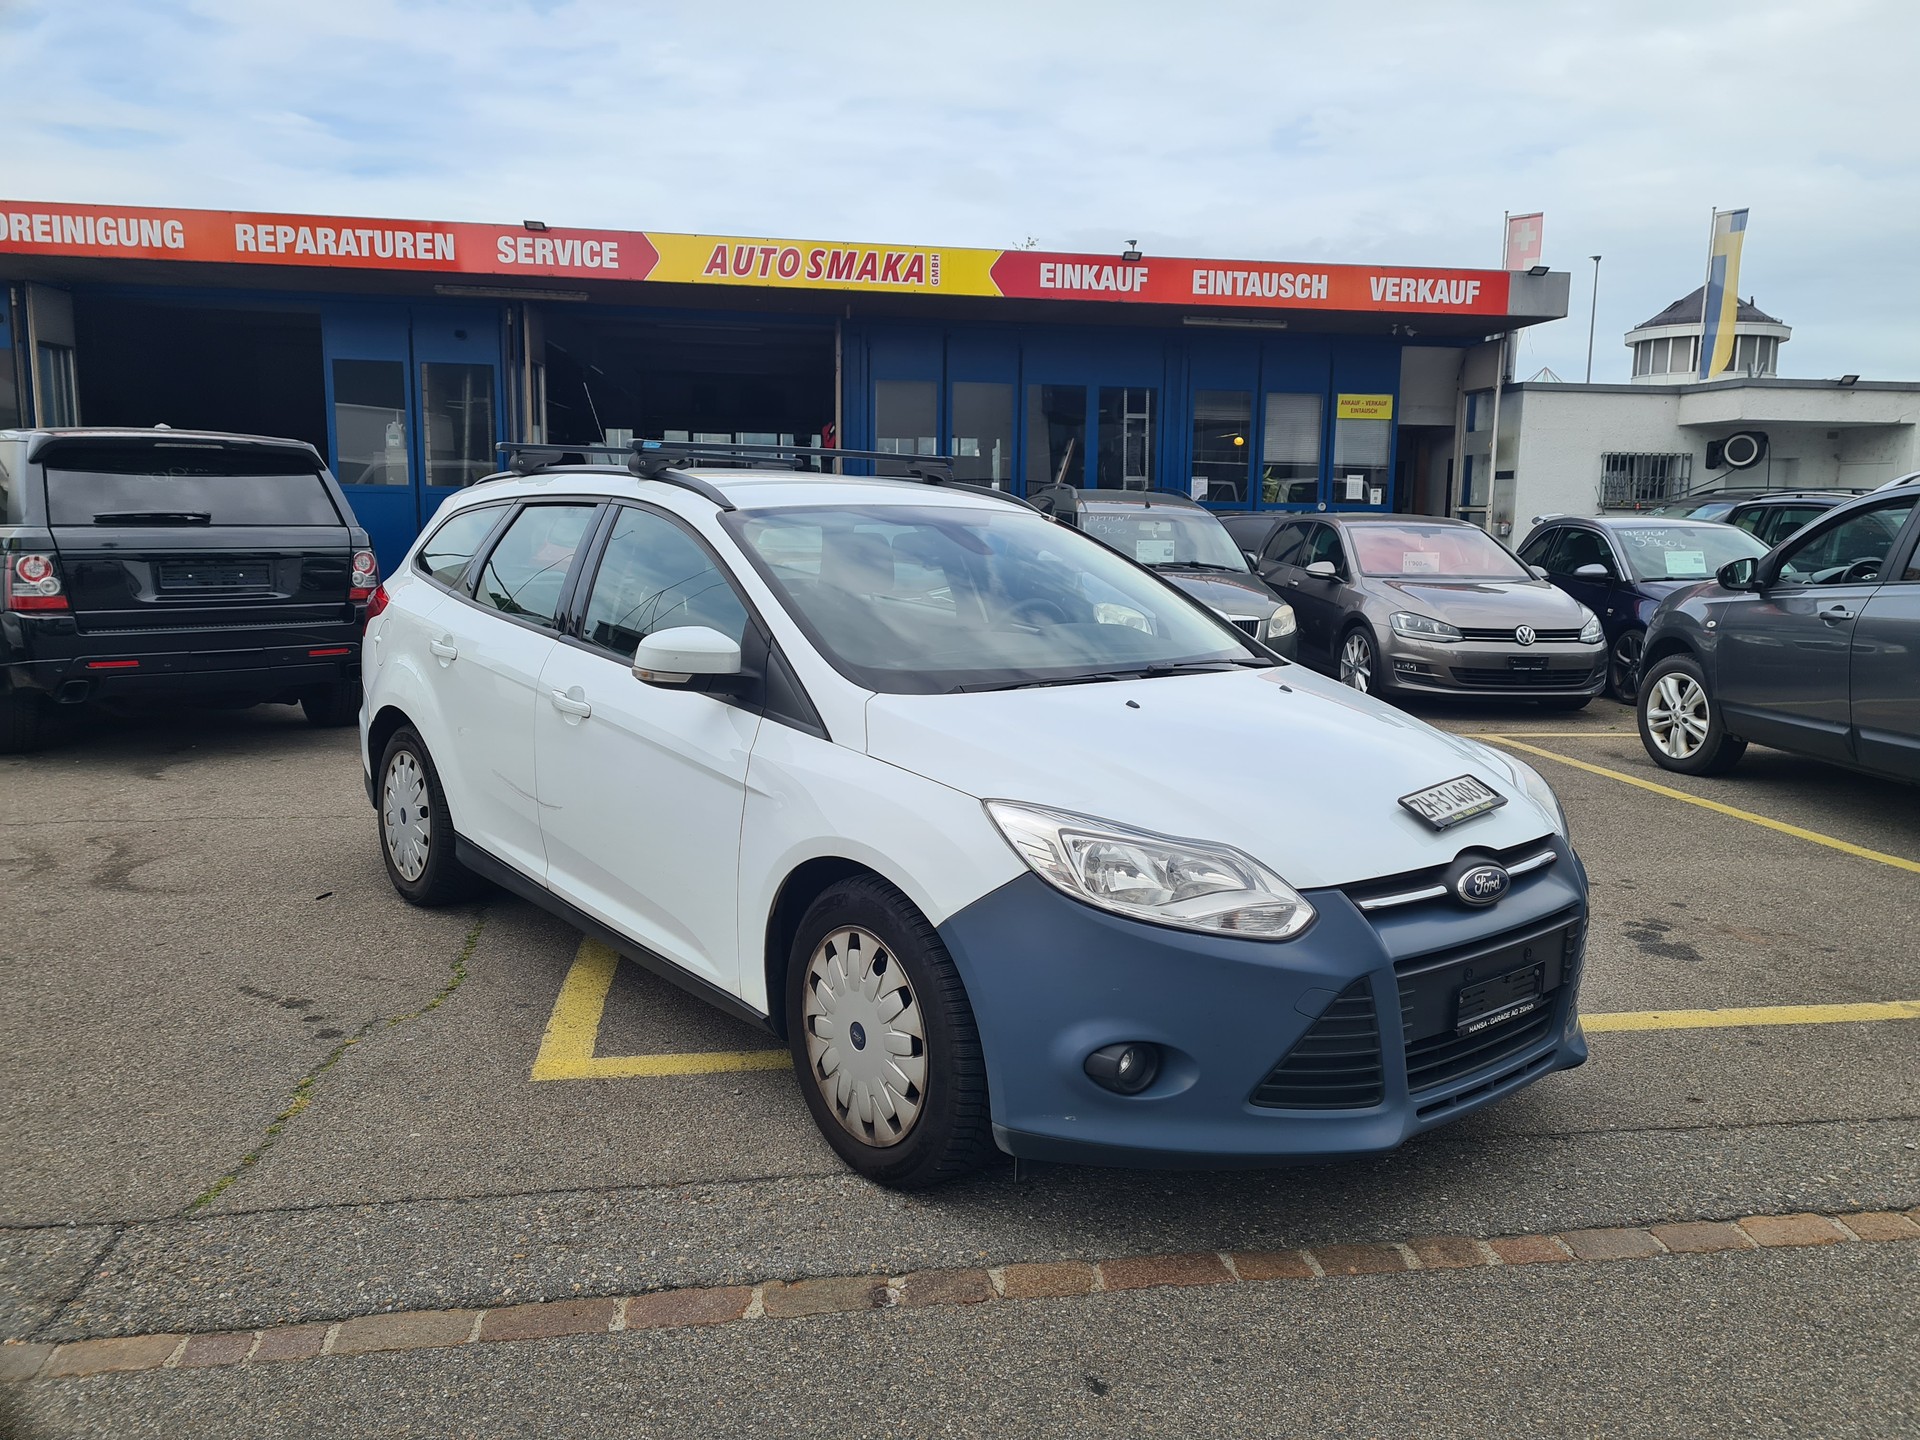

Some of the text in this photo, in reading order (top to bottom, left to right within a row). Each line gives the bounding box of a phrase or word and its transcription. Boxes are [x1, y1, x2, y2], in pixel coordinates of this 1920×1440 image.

[234, 224, 455, 261] REPARATUREN
[496, 236, 619, 269] SERVICE
[931, 254, 940, 286] GMBH
[1039, 262, 1149, 292] EINKAUF
[1192, 269, 1328, 300] EINTAUSCH
[1369, 276, 1481, 305] VERKAUF
[1474, 871, 1501, 895] Ford
[1490, 1012, 1510, 1025] GARAGE
